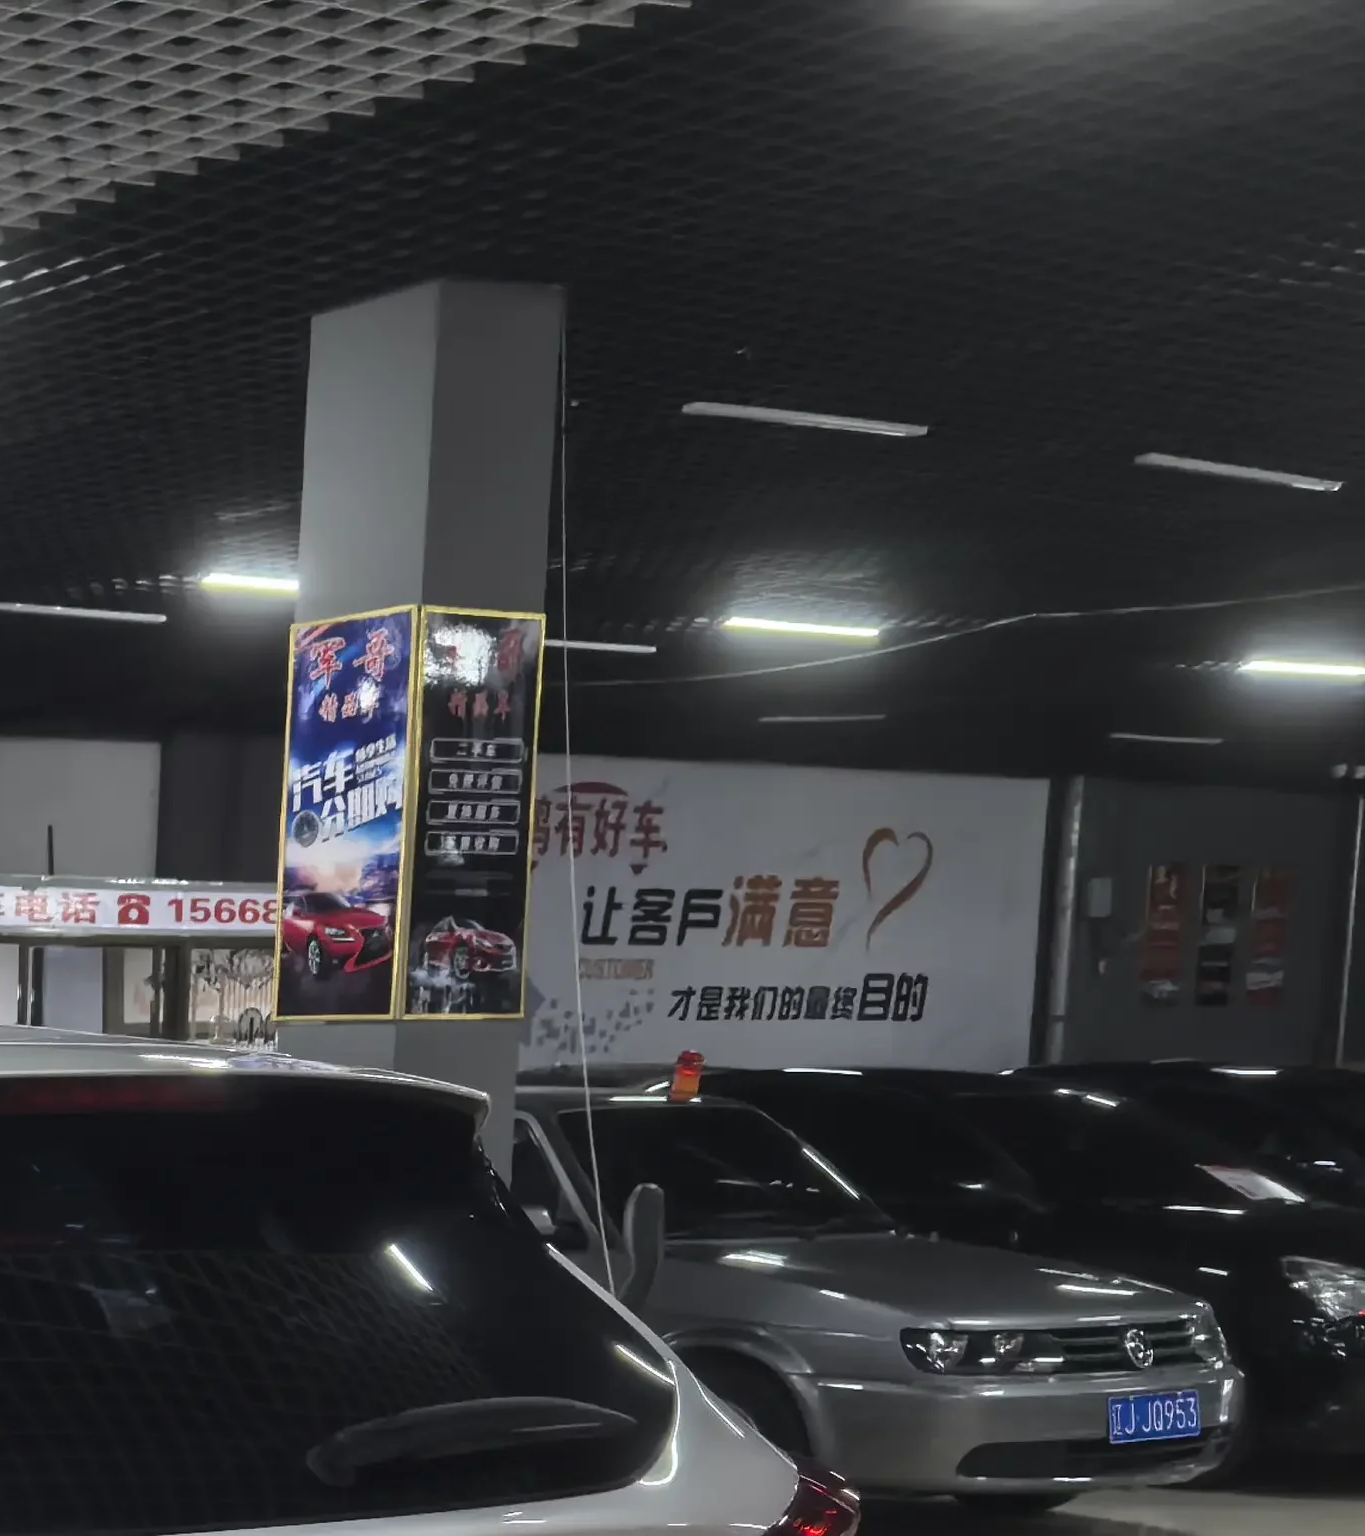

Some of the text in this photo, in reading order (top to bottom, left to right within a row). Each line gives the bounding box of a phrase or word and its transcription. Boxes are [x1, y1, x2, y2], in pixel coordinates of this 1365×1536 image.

[291, 748, 355, 812] 汽车
[581, 875, 840, 948] 让客户满意
[668, 972, 930, 1022] 才是我们的最终目的
